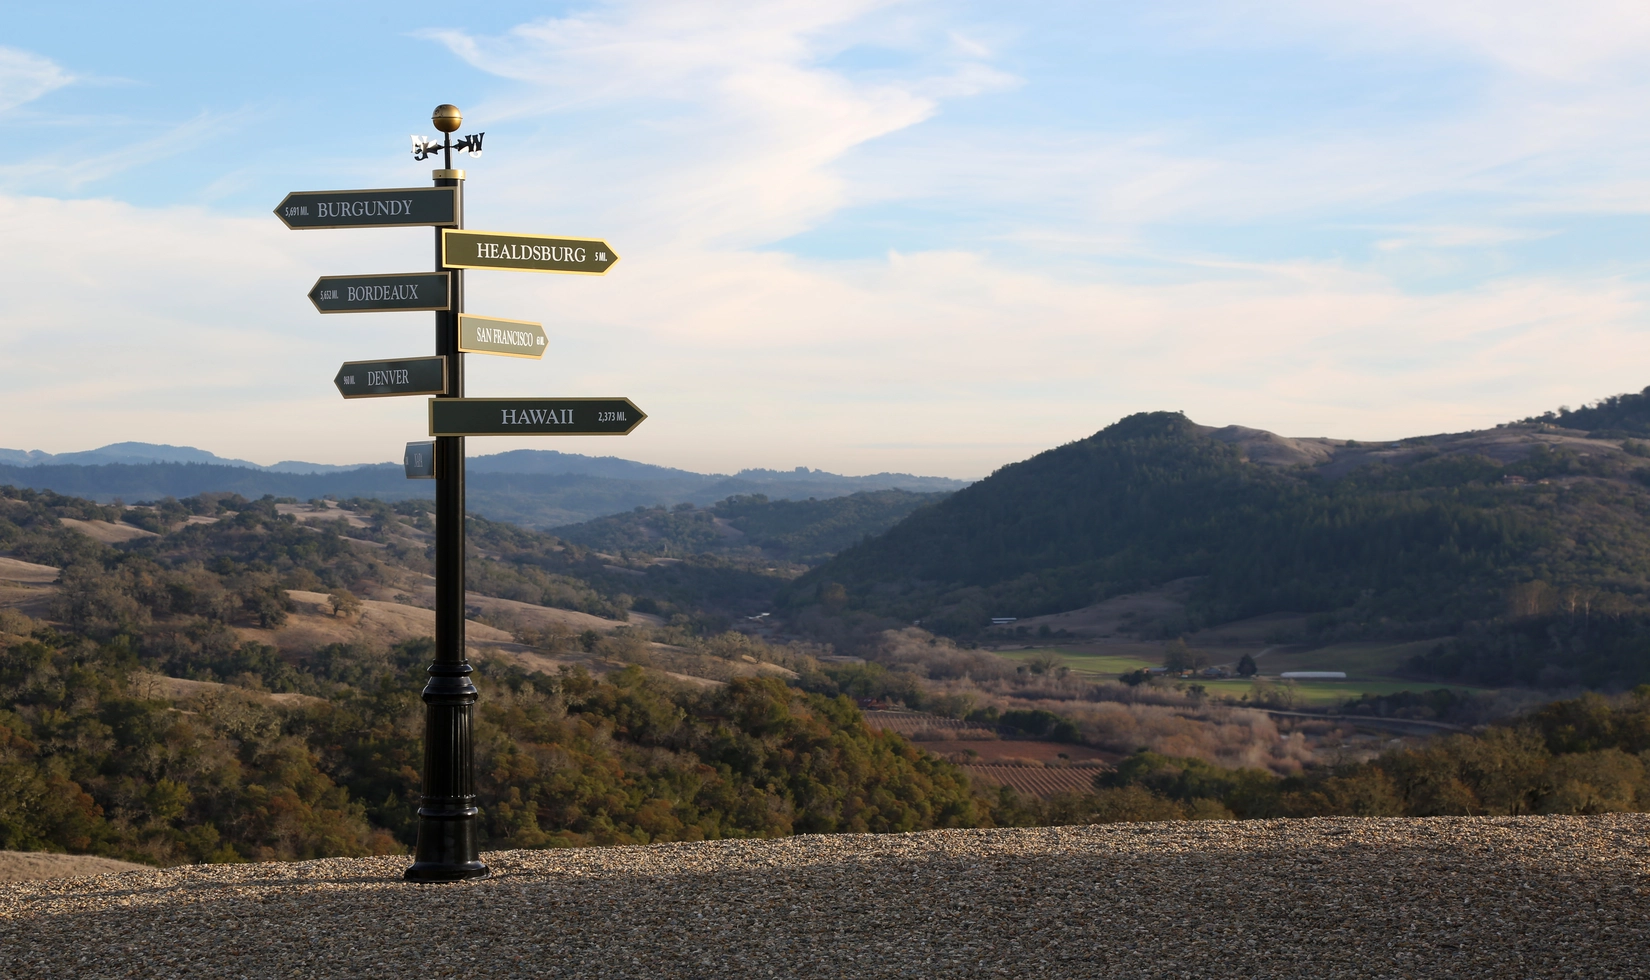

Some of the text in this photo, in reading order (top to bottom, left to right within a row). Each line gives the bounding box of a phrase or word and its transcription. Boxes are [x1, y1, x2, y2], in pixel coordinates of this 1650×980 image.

[285, 206, 300, 218] 5,691
[317, 200, 413, 218] BURGUNDY
[476, 242, 586, 262] HEALDSBURG
[594, 252, 599, 261] 5
[347, 284, 418, 302] BORDEAUX
[476, 327, 492, 343] SAN
[493, 328, 534, 347] FRANCISCO
[367, 369, 410, 386] DENVER
[501, 409, 627, 425] HAWAII 2,373 MI.
